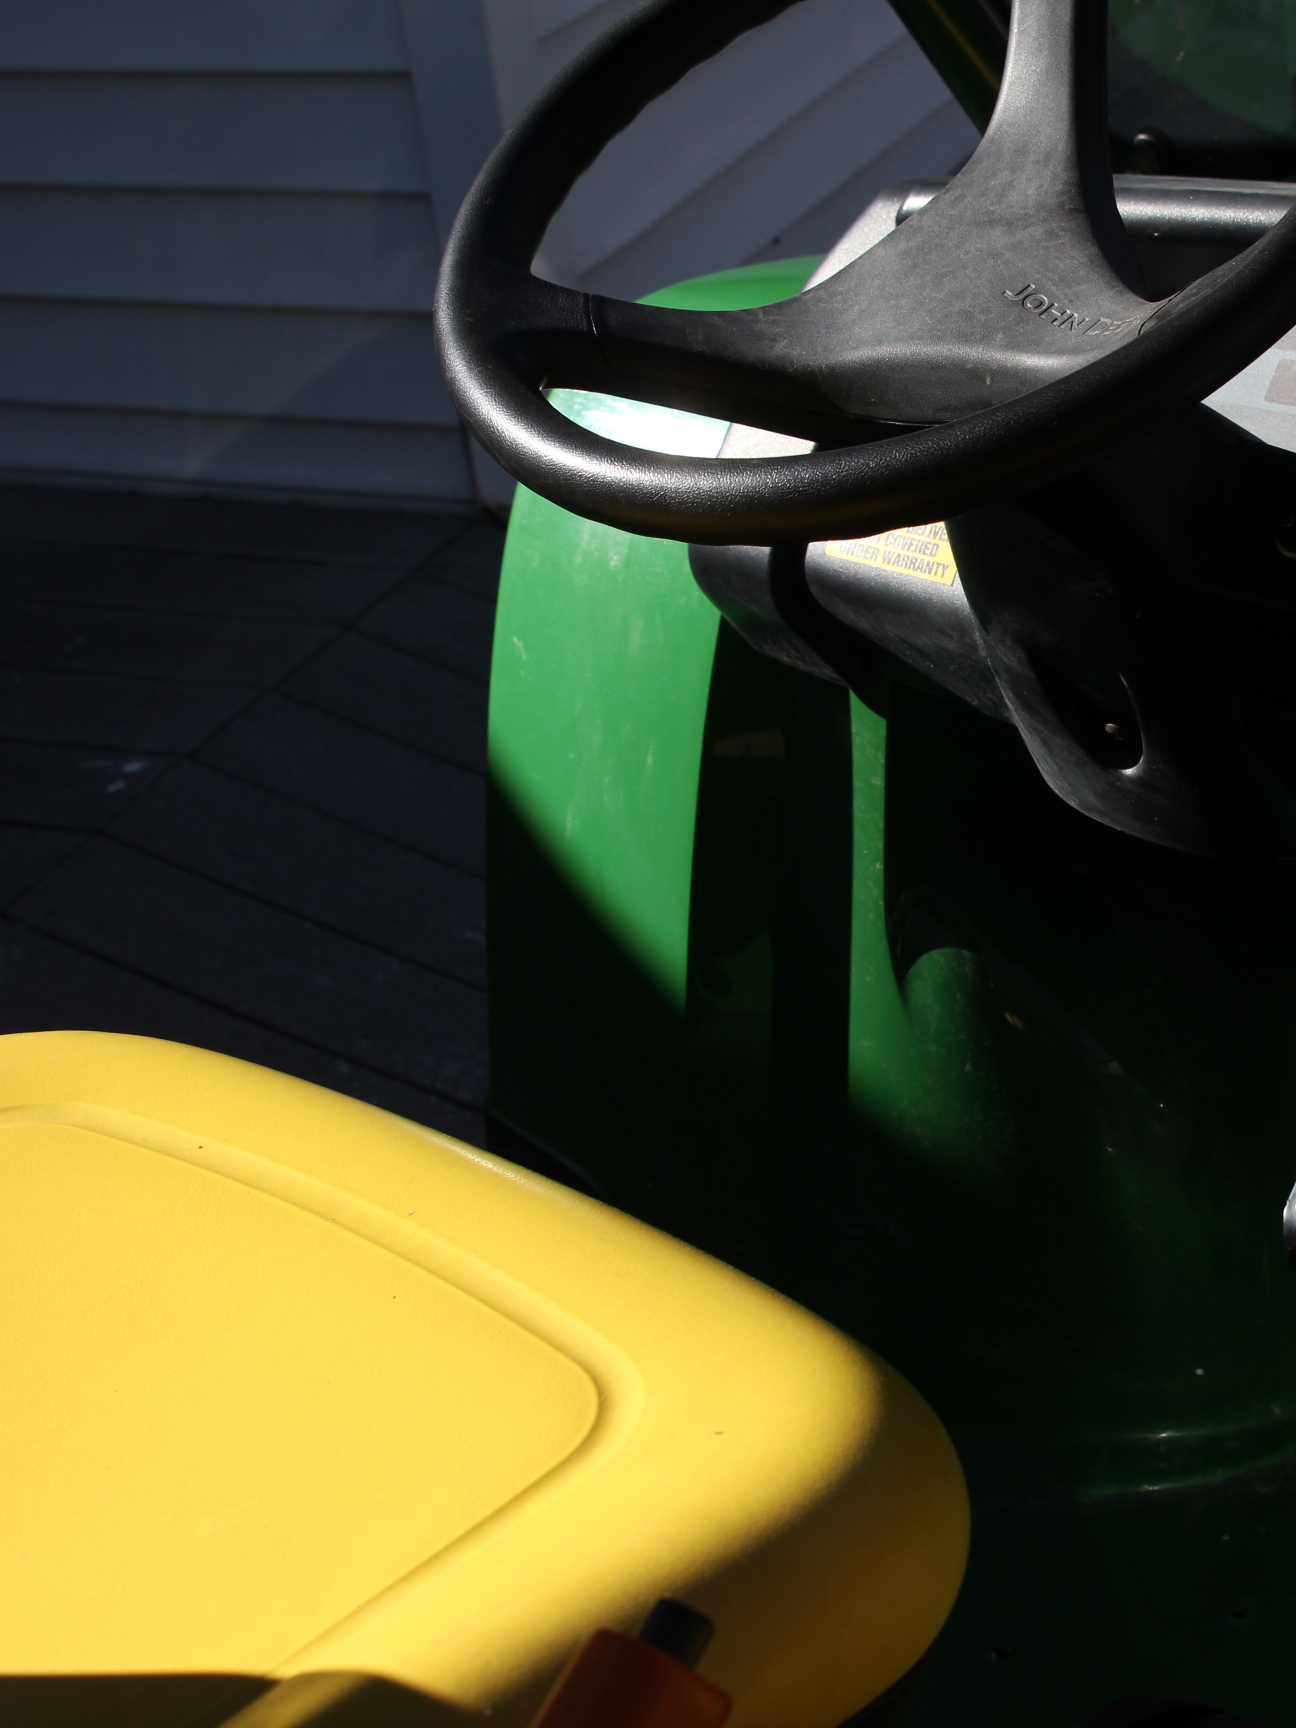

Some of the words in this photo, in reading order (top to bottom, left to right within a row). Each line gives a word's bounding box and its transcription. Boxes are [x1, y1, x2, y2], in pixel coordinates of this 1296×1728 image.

[1002, 283, 1089, 331] JOHN
[884, 532, 940, 558] COVERED
[906, 524, 949, 543] DELIVE
[838, 541, 879, 561] UNDER
[881, 549, 950, 578] WARRANTY
